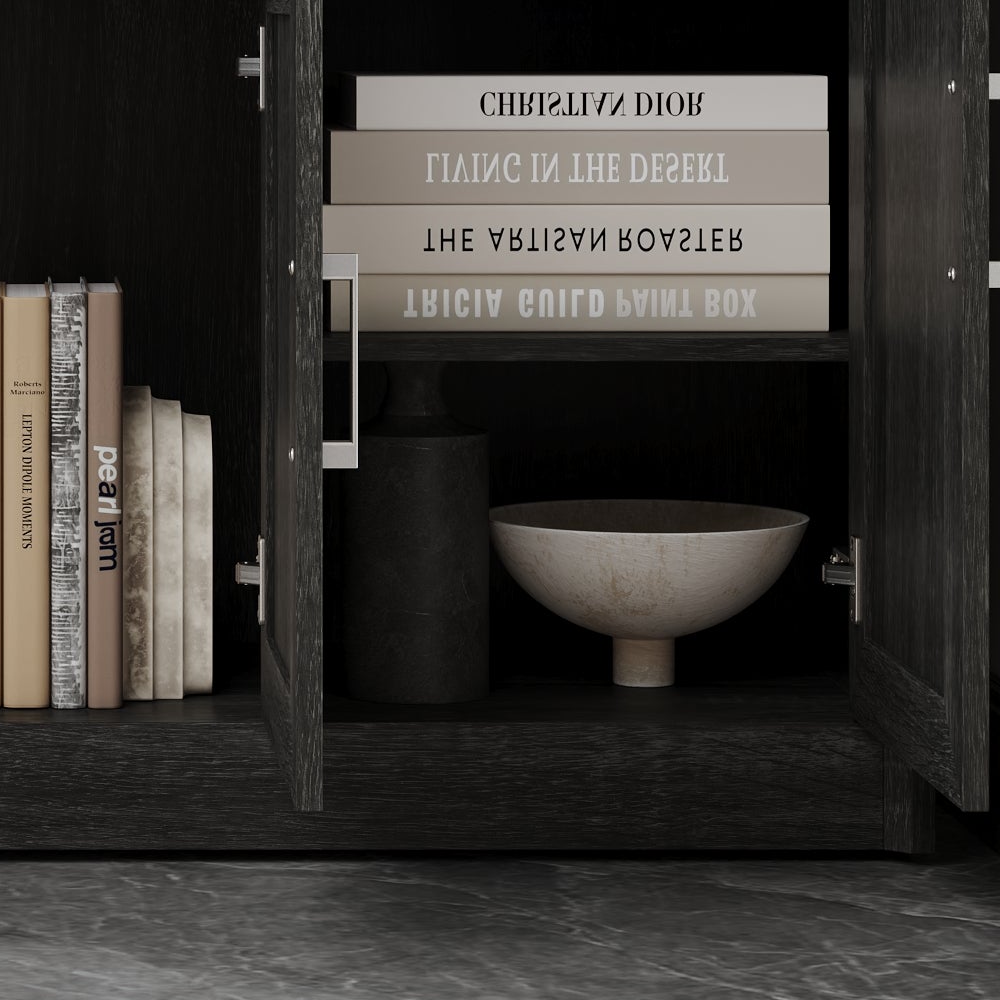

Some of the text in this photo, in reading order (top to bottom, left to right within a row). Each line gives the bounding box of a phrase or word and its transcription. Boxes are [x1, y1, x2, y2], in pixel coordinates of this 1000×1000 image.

[13, 380, 42, 388] Roberts
[21, 413, 33, 549] LEPTON DIPOLE MOMENTS
[93, 445, 122, 572] pearl jam
